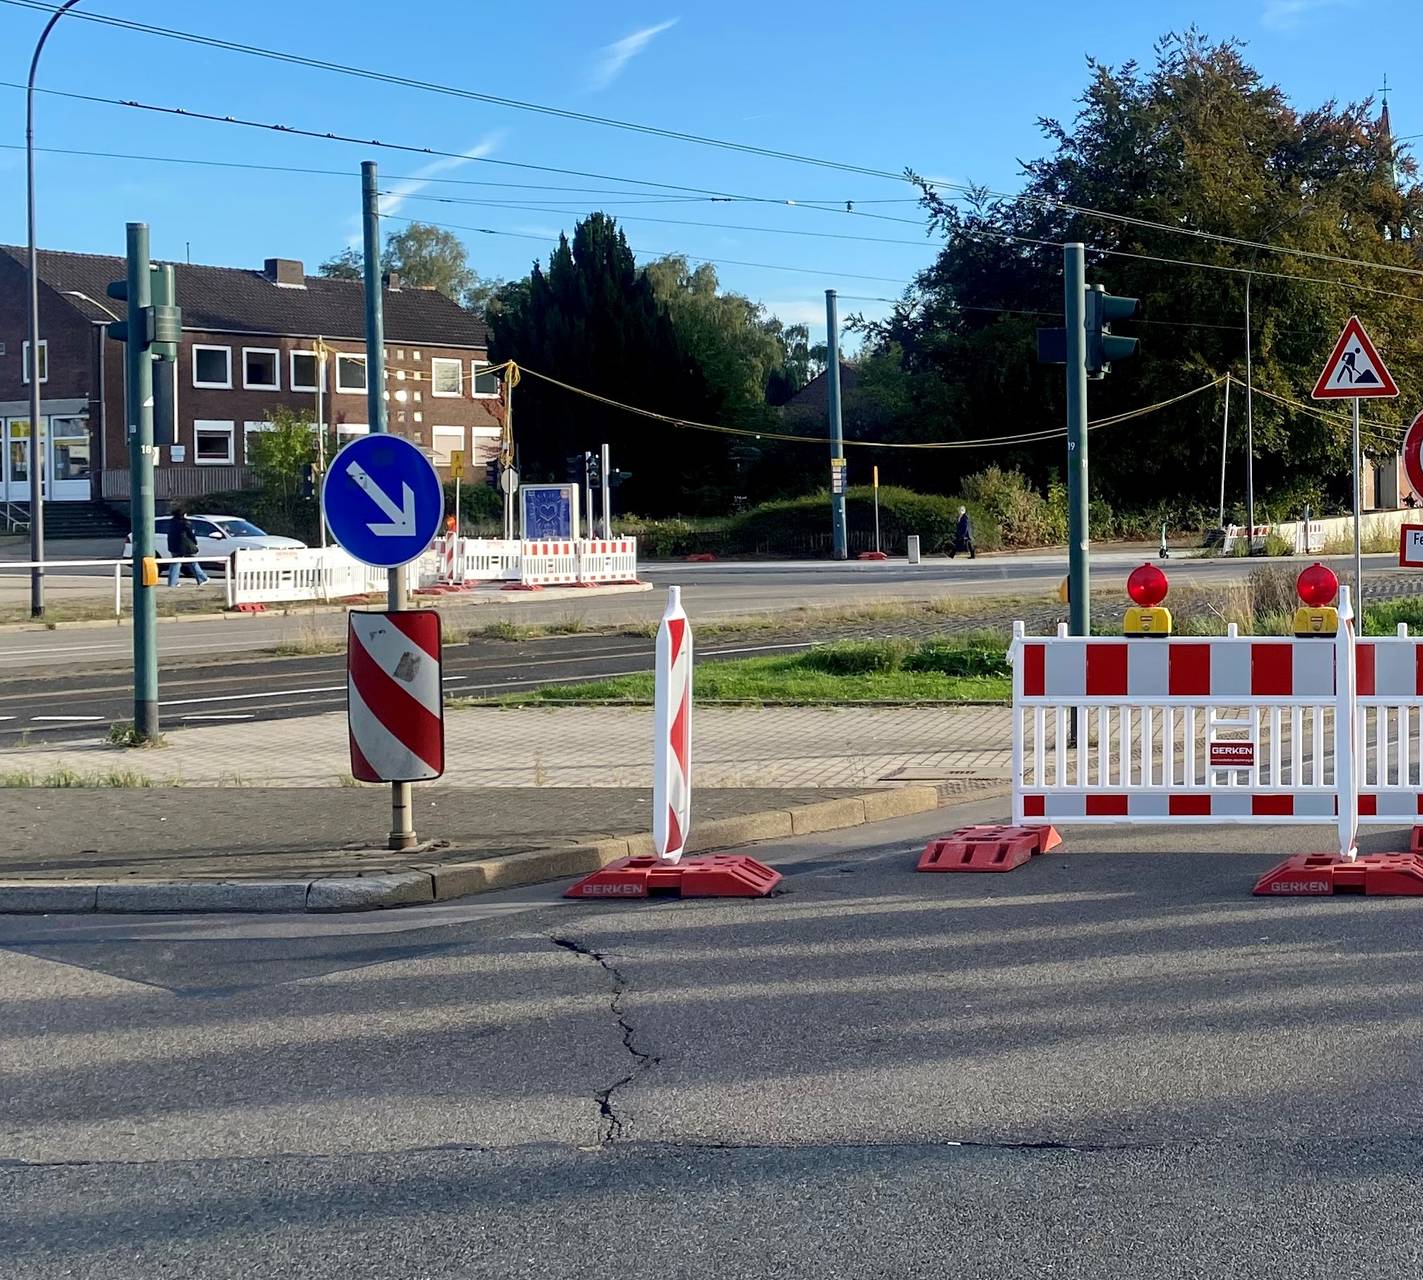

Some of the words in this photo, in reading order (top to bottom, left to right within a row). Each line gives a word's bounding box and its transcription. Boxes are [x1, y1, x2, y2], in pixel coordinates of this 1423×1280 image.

[1211, 746, 1253, 755] GERKEN
[583, 883, 642, 894] GERKEN
[1271, 881, 1329, 891] GERKEN
